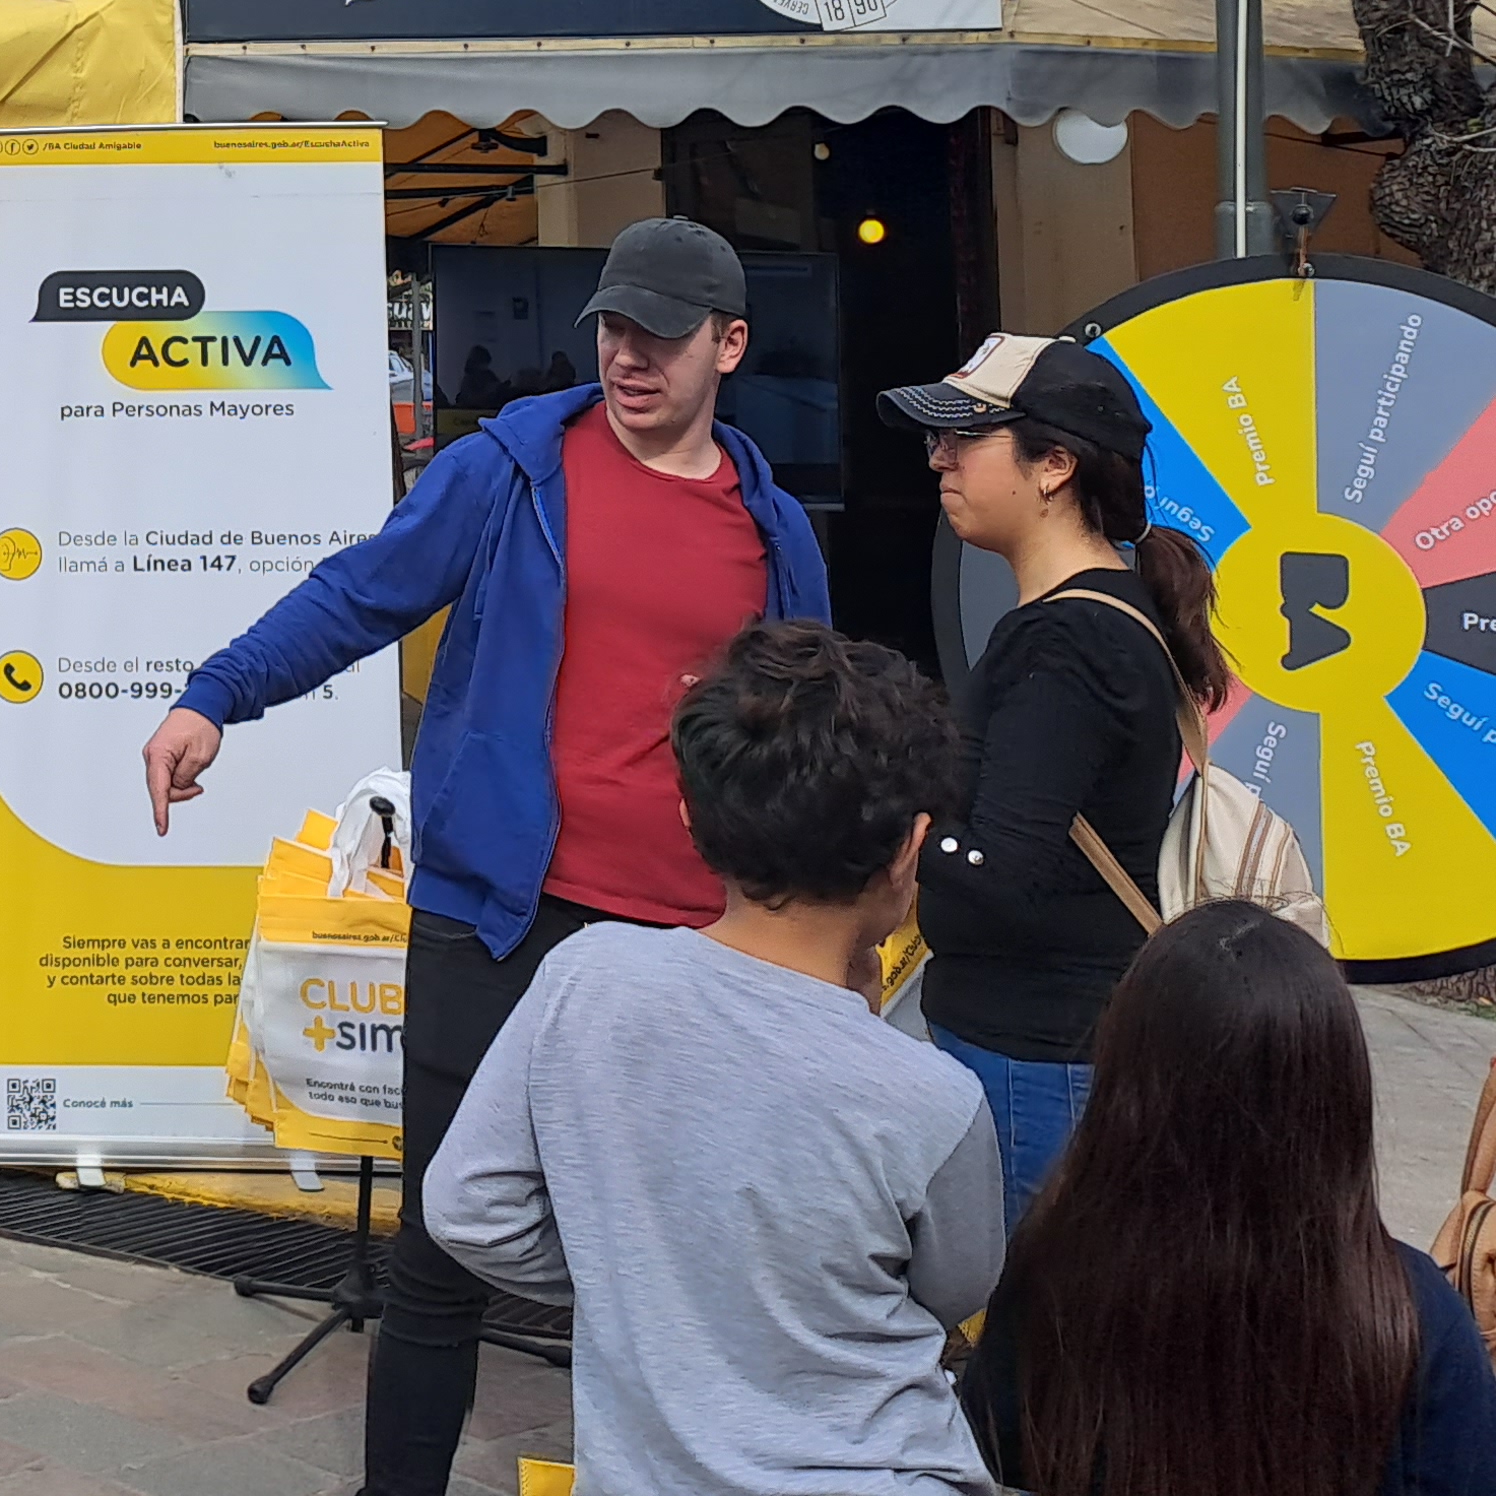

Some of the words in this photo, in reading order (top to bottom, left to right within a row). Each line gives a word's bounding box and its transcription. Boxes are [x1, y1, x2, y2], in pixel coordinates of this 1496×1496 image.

[43, 142, 62, 151] /BA
[63, 141, 96, 151] Ciudad
[98, 141, 142, 152] Amigable
[213, 139, 371, 151] buenosaires.gob.ar/EscuchaActiva
[58, 286, 190, 308] ESCUCHA
[129, 335, 292, 368] ACTIVA
[1221, 375, 1249, 410] BA
[60, 404, 105, 422] para
[111, 401, 203, 418] Personas
[209, 401, 294, 421] Mayores
[1343, 442, 1379, 505] Seguí
[1367, 311, 1424, 444] participando
[1237, 412, 1276, 487] Premio
[58, 530, 117, 546] Desde
[124, 530, 140, 546] la
[145, 530, 213, 546] Ciudad
[220, 530, 244, 546] de
[251, 530, 322, 546] Buenos
[1414, 510, 1465, 552] Otra
[58, 557, 108, 573] llamá
[114, 561, 125, 573] a
[133, 555, 193, 573] Línea
[199, 555, 243, 575] 147,
[249, 557, 315, 577] opción
[58, 657, 117, 673] Desde
[124, 656, 139, 673] el
[146, 658, 195, 673] resto
[58, 681, 189, 700] 0800-999-
[1423, 682, 1490, 733] Seguí
[1255, 721, 1287, 785] Seguí
[1354, 741, 1395, 819] Premio
[1384, 822, 1412, 858] BA
[62, 935, 127, 951] Siempre
[131, 938, 157, 950] vas
[161, 939, 171, 950] a
[175, 936, 251, 950] encontrar
[39, 954, 120, 970] disponible
[125, 957, 159, 970] para
[164, 957, 243, 970] conversar,
[46, 976, 56, 988] y
[60, 973, 126, 987] contarte
[130, 972, 175, 987] sobre
[179, 972, 223, 987] todas
[107, 992, 136, 1007] que
[141, 992, 209, 1005] tenemos
[300, 978, 407, 1015] CLUB
[307, 1078, 356, 1092] Encontrá
[359, 1085, 380, 1095] con
[63, 1097, 106, 1109] Conocé
[110, 1096, 134, 1109] más
[309, 1091, 336, 1103] todo
[360, 1098, 382, 1108] que
